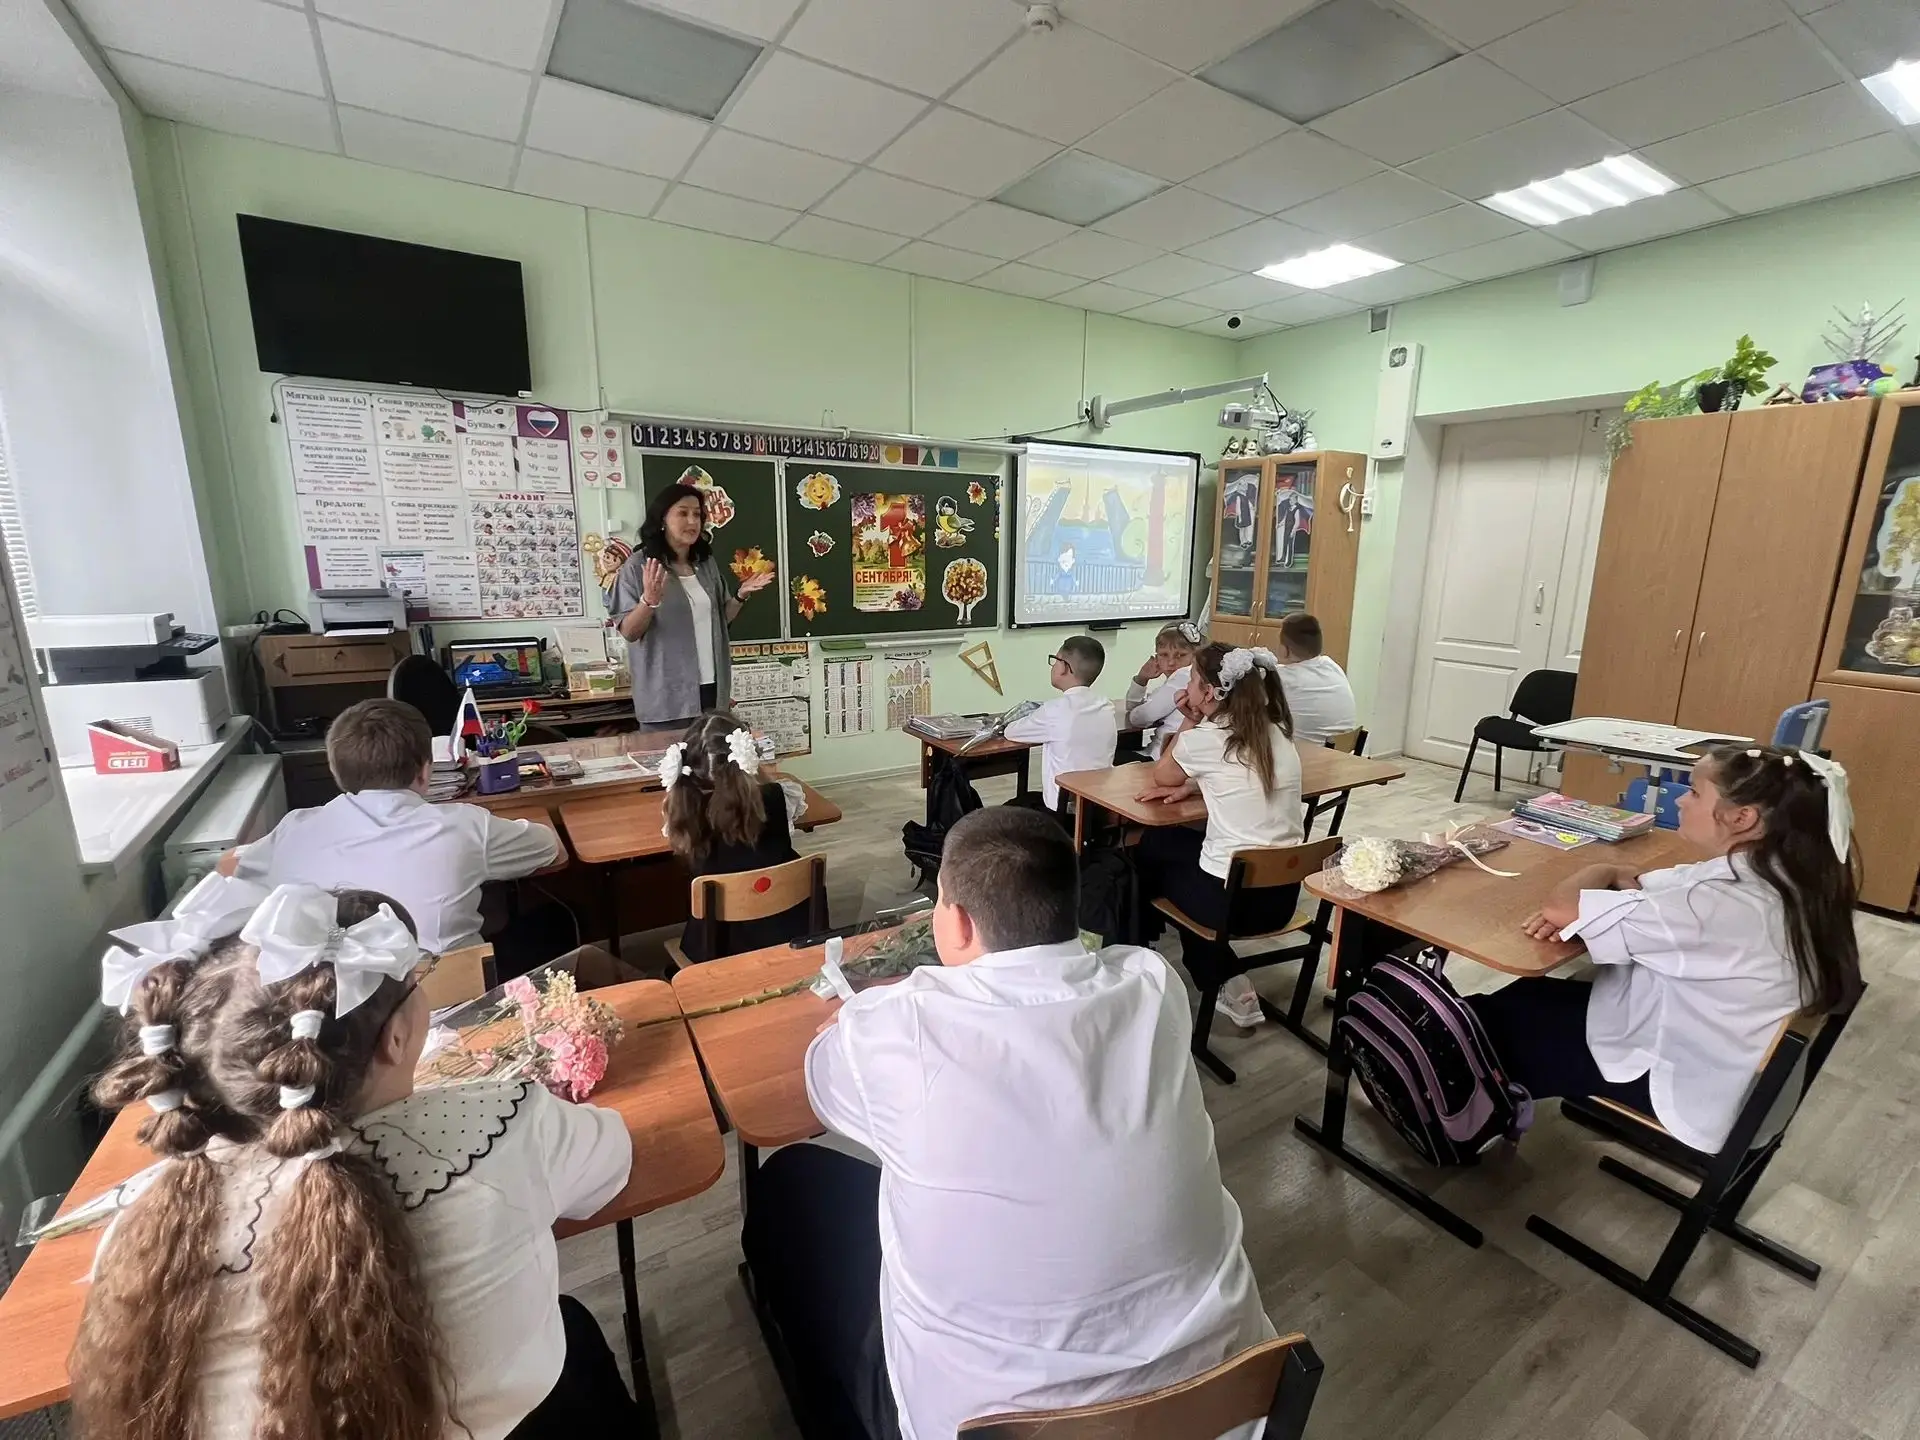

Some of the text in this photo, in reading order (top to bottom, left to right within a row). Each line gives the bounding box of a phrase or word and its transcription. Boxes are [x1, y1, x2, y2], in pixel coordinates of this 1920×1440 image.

[286, 391, 325, 401] Мягкий
[328, 395, 351, 403] знак
[466, 438, 504, 447] Гласные
[633, 425, 880, 461] 0 1 2 3 4 5 6 7 8 9 10 11 12 13 14 15 16 17 18 19 20
[498, 493, 545, 501] АЛФАВИТ
[316, 499, 367, 508] Предлоги:
[855, 570, 912, 583] СЕНТЯБРЯ!
[110, 758, 146, 768] СТЕП
